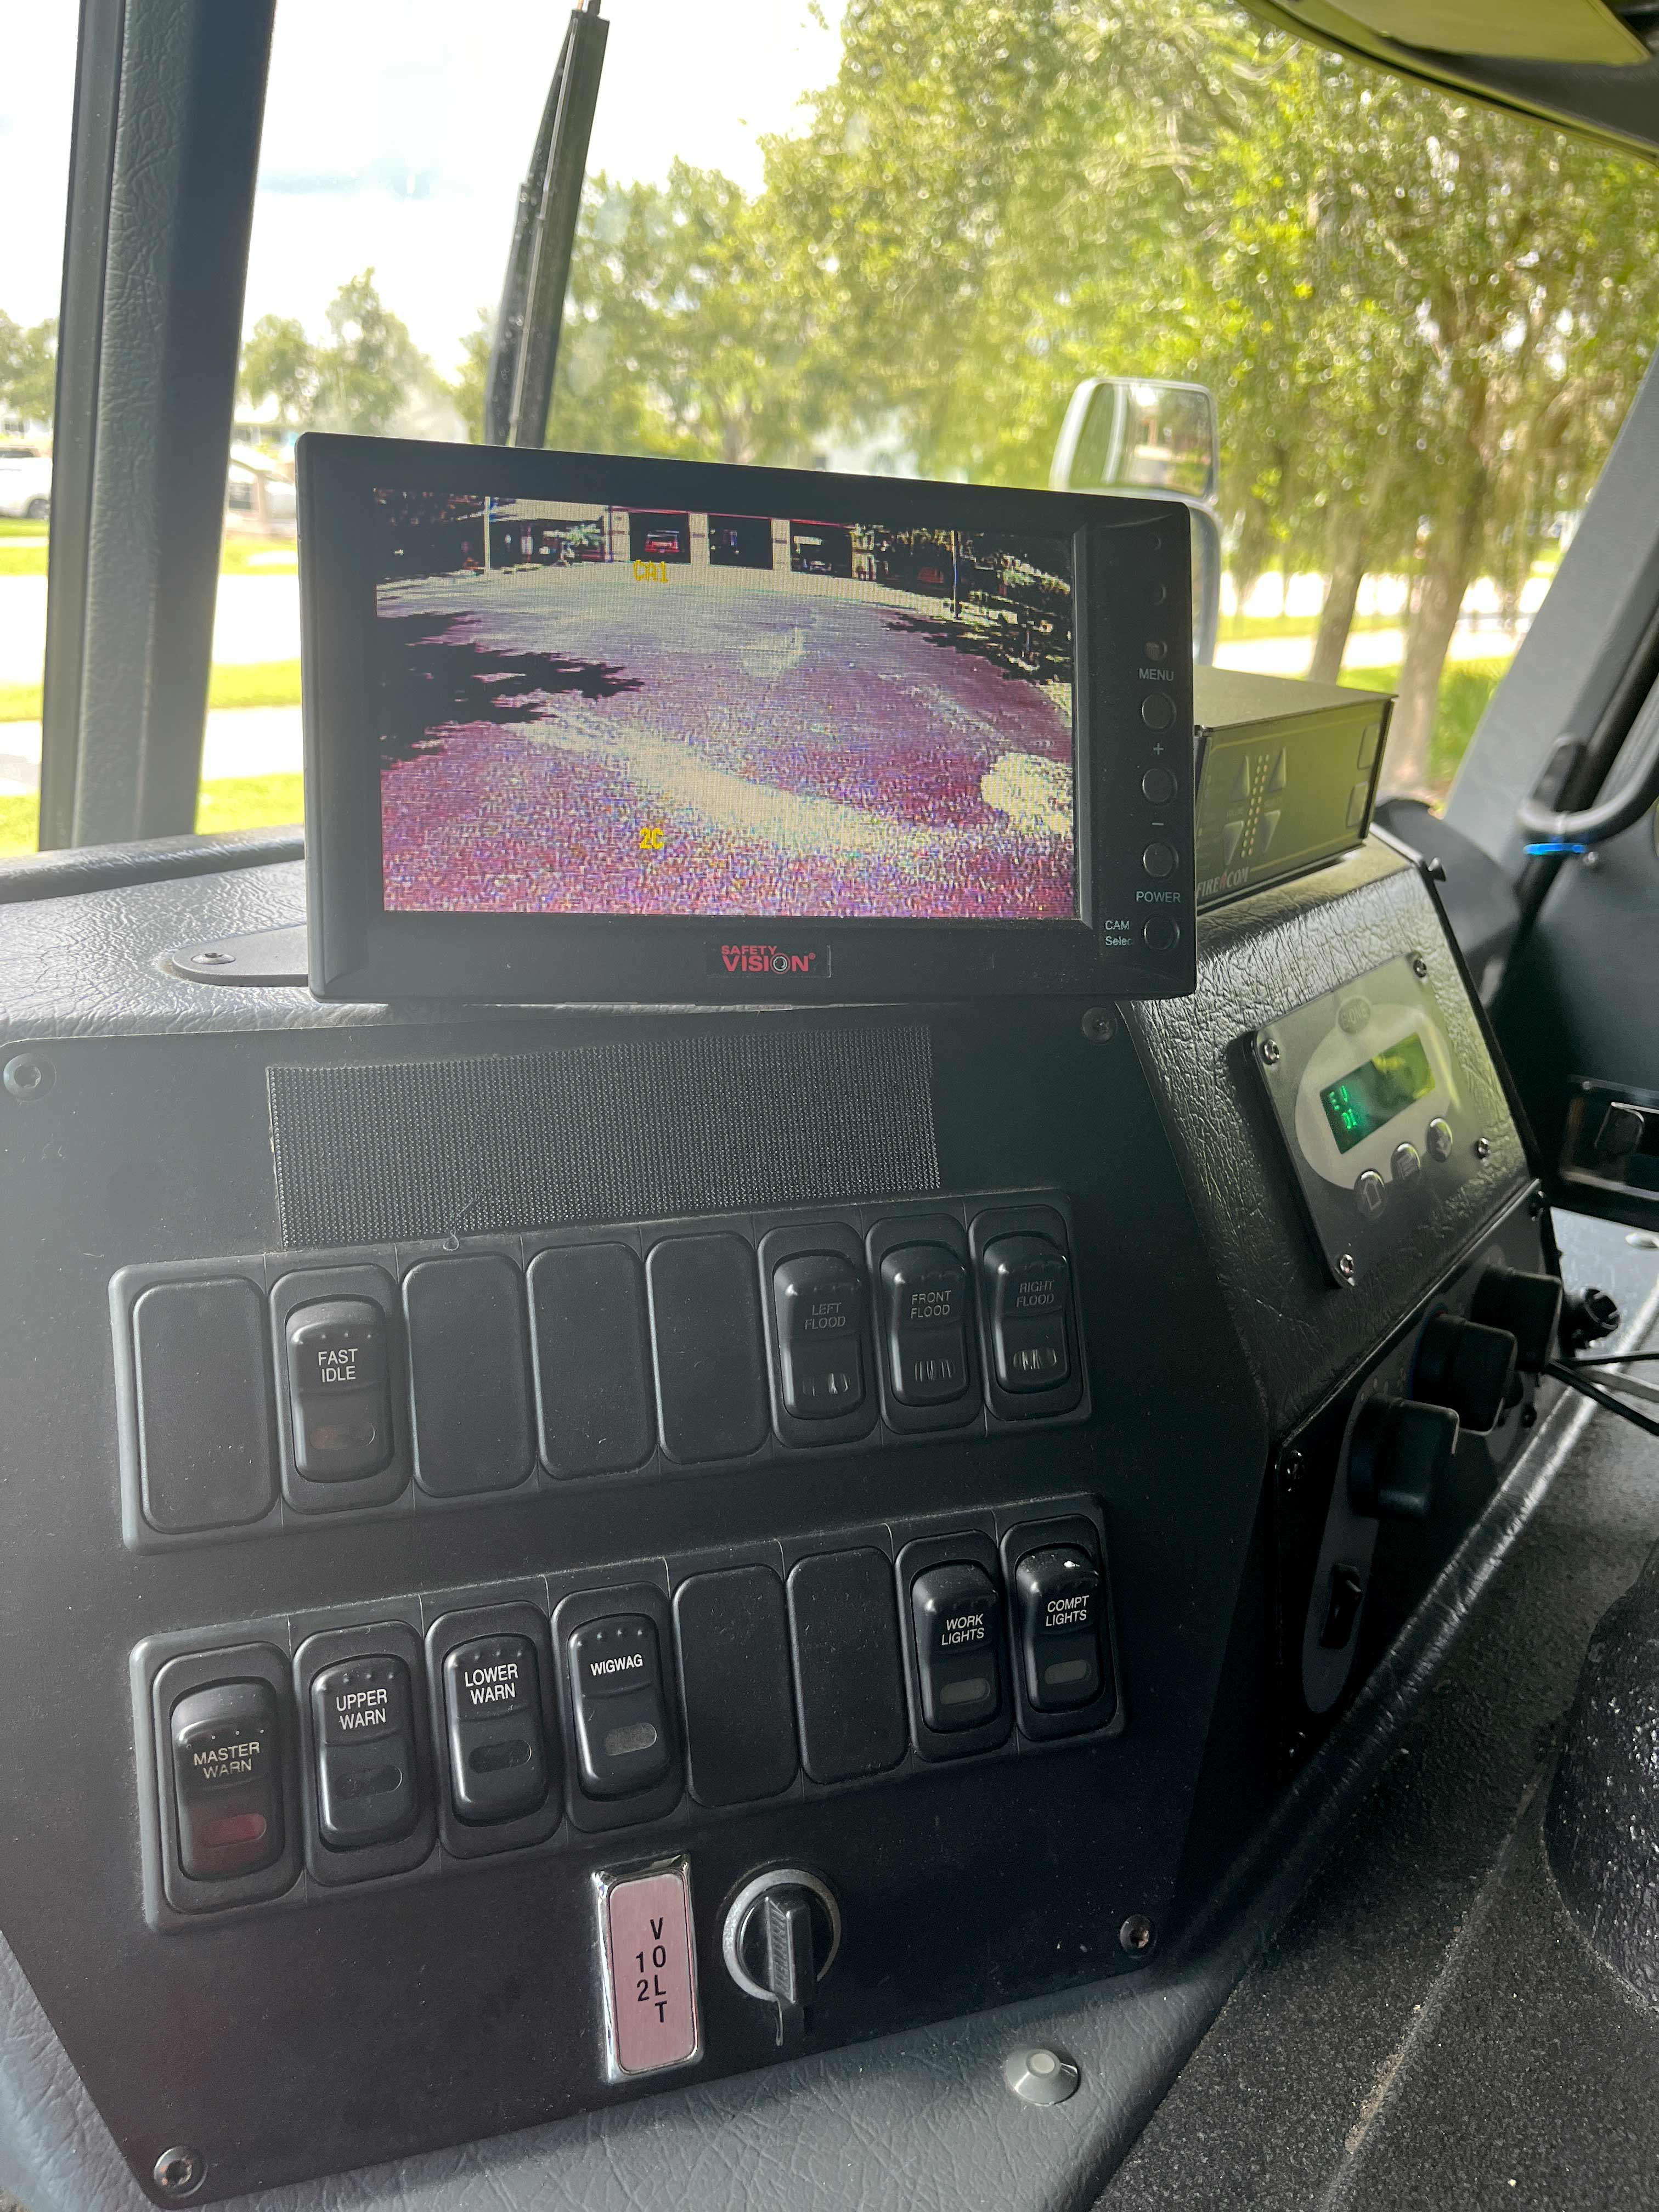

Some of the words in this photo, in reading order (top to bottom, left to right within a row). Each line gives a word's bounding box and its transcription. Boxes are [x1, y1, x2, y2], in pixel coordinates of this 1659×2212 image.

[634, 559, 669, 583] CA1
[1139, 668, 1174, 681] MENU
[1136, 891, 1181, 903] POWER
[1105, 920, 1130, 930] CAM
[721, 945, 777, 955] SAFETY
[722, 953, 809, 974] VISION
[1019, 1279, 1054, 1293] RIGHT
[911, 1290, 951, 1305] FRONT
[1016, 1293, 1054, 1307] FLOOD
[811, 1302, 842, 1316] LEFT
[911, 1304, 950, 1319] FLOOD
[804, 1316, 846, 1330] FLOOD
[318, 1348, 358, 1366] FAST
[321, 1365, 356, 1383] IDLE
[1047, 1595, 1090, 1613] COMPT
[946, 1613, 984, 1631] WORK
[1045, 1609, 1087, 1627] LIGHTS
[941, 1628, 984, 1646] LIGHTS
[590, 1654, 643, 1677] WIGWAG
[465, 1663, 518, 1687] LOWER
[336, 1689, 387, 1711] UPPER
[470, 1682, 516, 1705] WARN
[339, 1708, 386, 1730] WARN
[194, 1741, 260, 1766] MASTER
[203, 1758, 252, 1779] WARN
